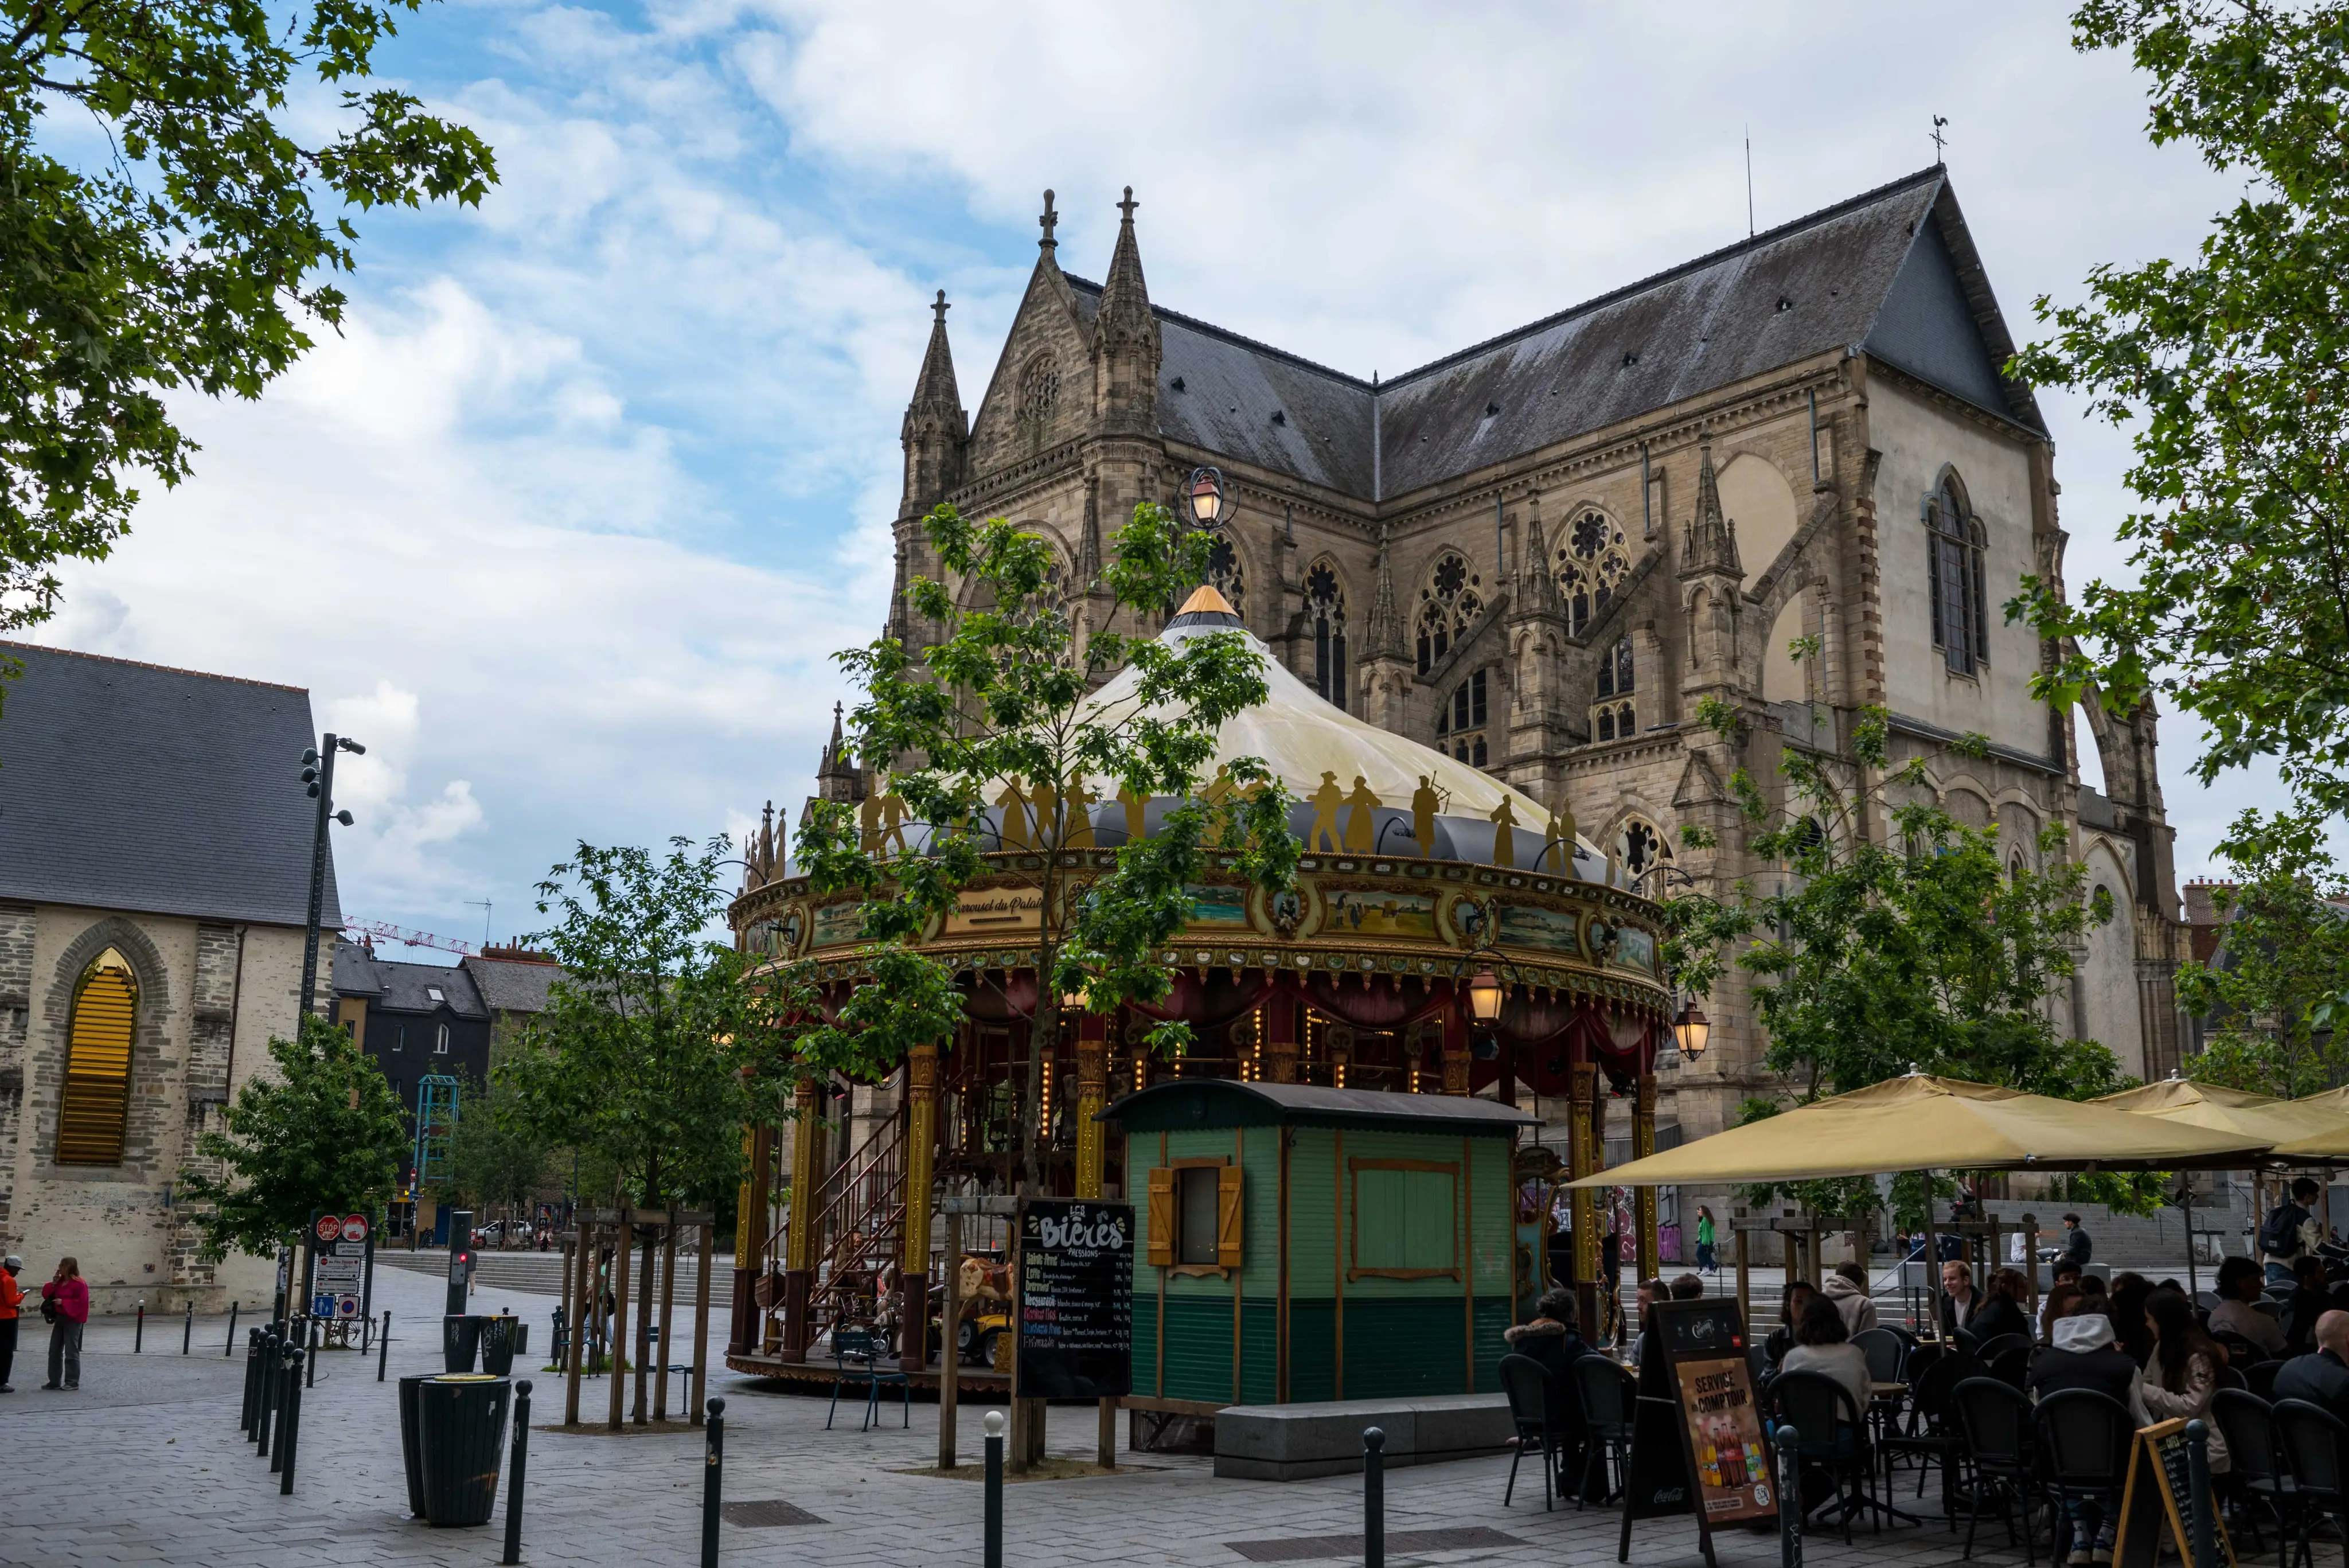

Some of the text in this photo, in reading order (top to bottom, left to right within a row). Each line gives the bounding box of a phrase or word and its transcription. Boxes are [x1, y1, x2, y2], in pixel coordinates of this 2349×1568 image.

[994, 899, 1008, 912] du
[1070, 1205, 1085, 1215] LES
[1040, 1215, 1123, 1249] Bières
[1068, 1247, 1098, 1258] PRESSIONS
[1695, 1371, 1735, 1394] SERVICE
[1698, 1389, 1747, 1413] COMPTOIR
